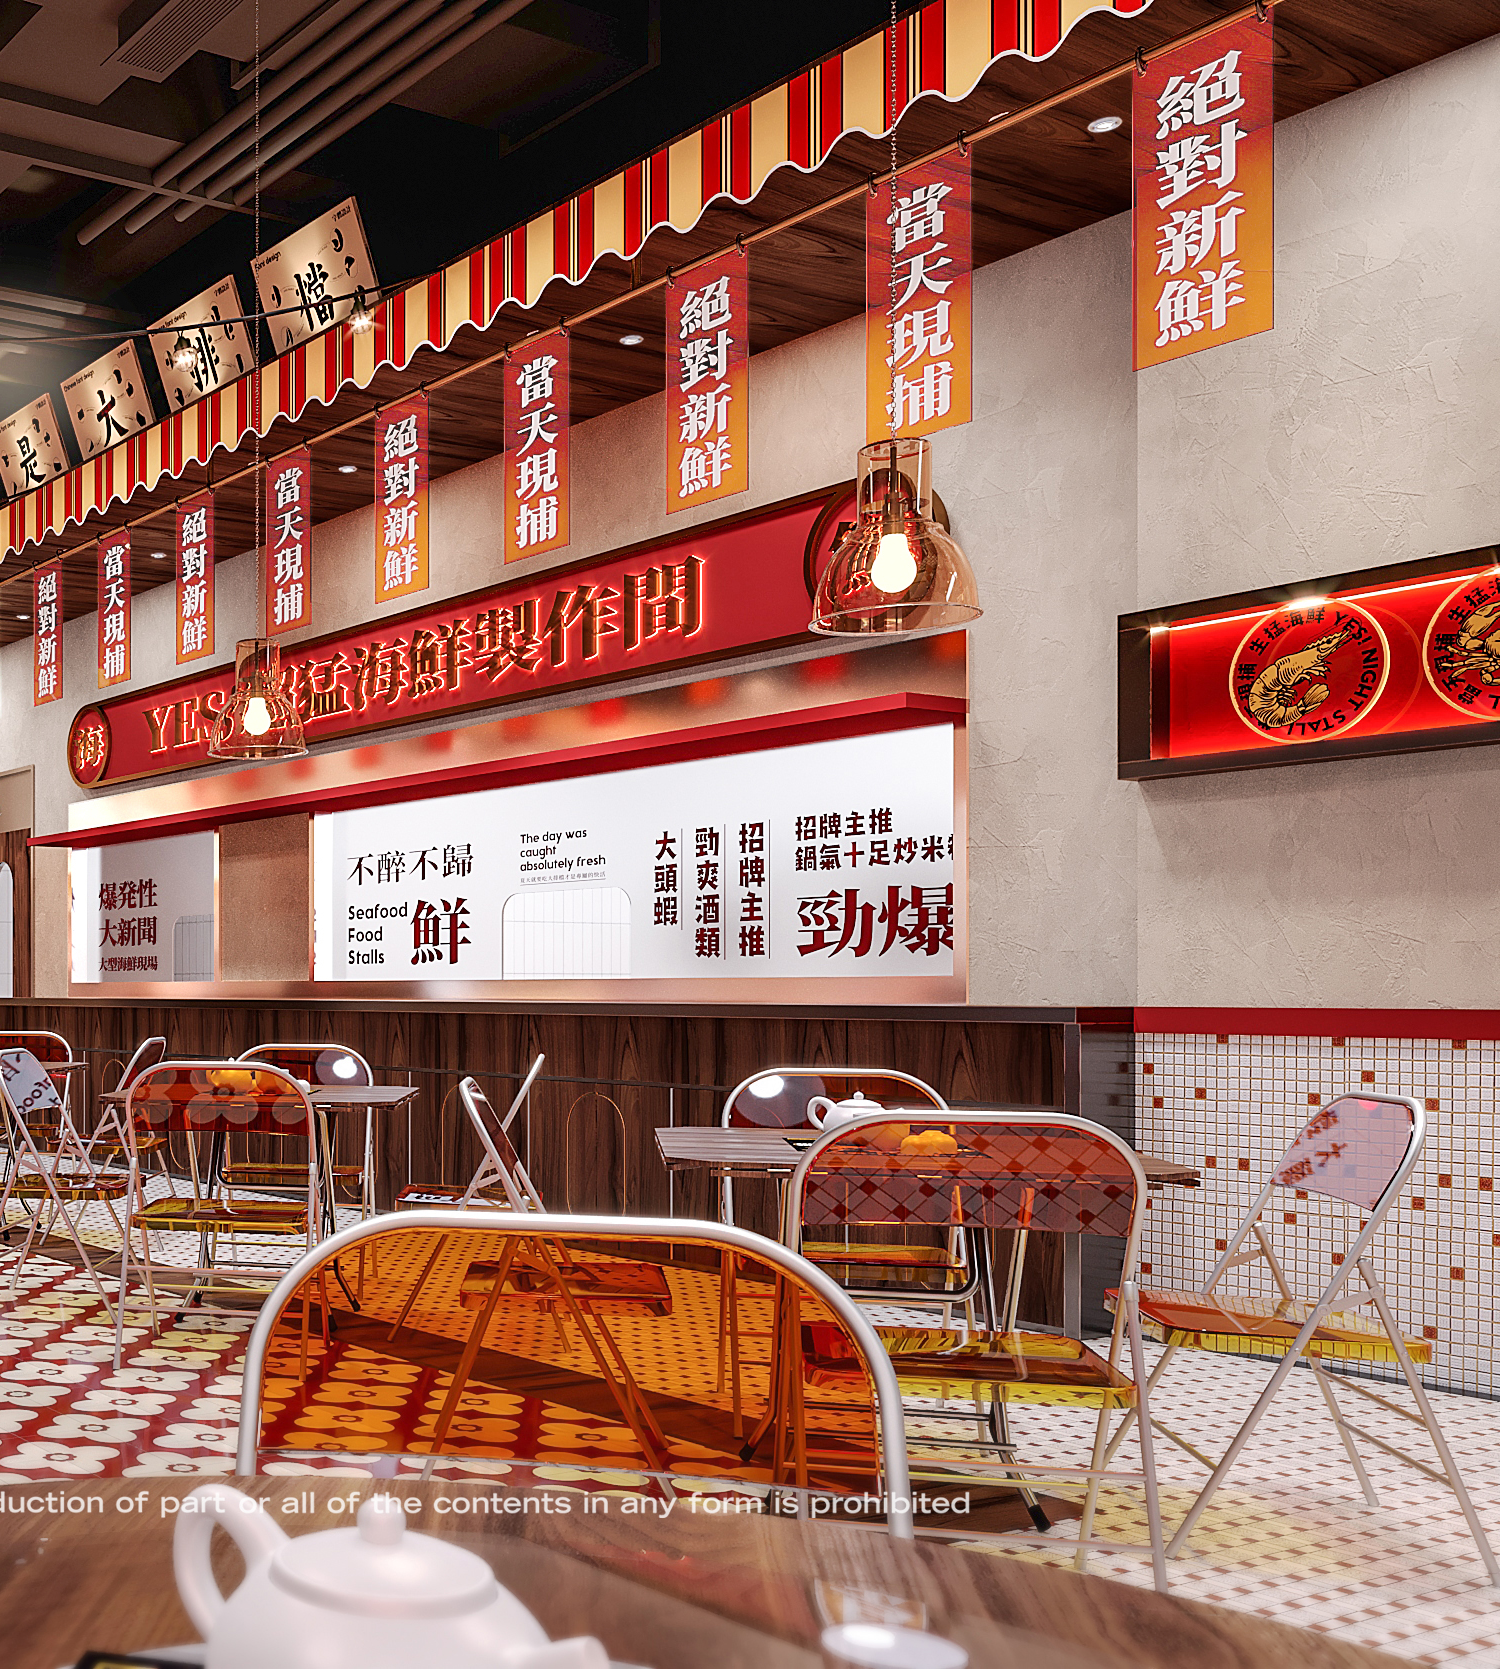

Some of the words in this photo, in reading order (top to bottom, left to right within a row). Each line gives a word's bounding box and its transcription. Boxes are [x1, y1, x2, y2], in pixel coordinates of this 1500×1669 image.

[1155, 49, 1247, 349] 絕對新鮮
[886, 182, 954, 430] 當天現捕
[678, 275, 733, 498] 絕對新鮮
[16, 435, 47, 488] 是
[97, 389, 130, 448] 大
[516, 354, 559, 549] 當天現捕
[383, 414, 419, 591] 絕對新鮮
[274, 467, 304, 626] 當天現捕
[103, 545, 126, 679] 當天現捕
[182, 507, 208, 655] 絕對新鮮
[37, 571, 58, 698] 絕對新鮮
[1249, 606, 1325, 656] 生猛海鮮
[1348, 648, 1378, 711] NIGHT
[75, 724, 105, 770] 海
[519, 833, 540, 844] The
[542, 830, 563, 845] day
[565, 829, 587, 839] was
[519, 845, 557, 860] caught
[794, 807, 894, 841] 招牌主推
[794, 834, 954, 872] 鍋氣十足炒米
[98, 878, 158, 911] 爆発性
[347, 842, 474, 887] 不醉不歸
[519, 857, 574, 872] absolutely
[576, 854, 606, 867] fresh
[653, 830, 678, 926] 大頭蝦
[695, 826, 721, 958] 勁爽酒類
[738, 822, 766, 957] 招牌主推
[98, 915, 158, 948] 大新聞
[348, 901, 408, 920] Seafood
[348, 927, 383, 943] Food
[410, 896, 472, 966] 鮮
[796, 882, 954, 959] 勁爆
[98, 955, 158, 972] 大型海鮮現場
[348, 948, 385, 965] Stalls
